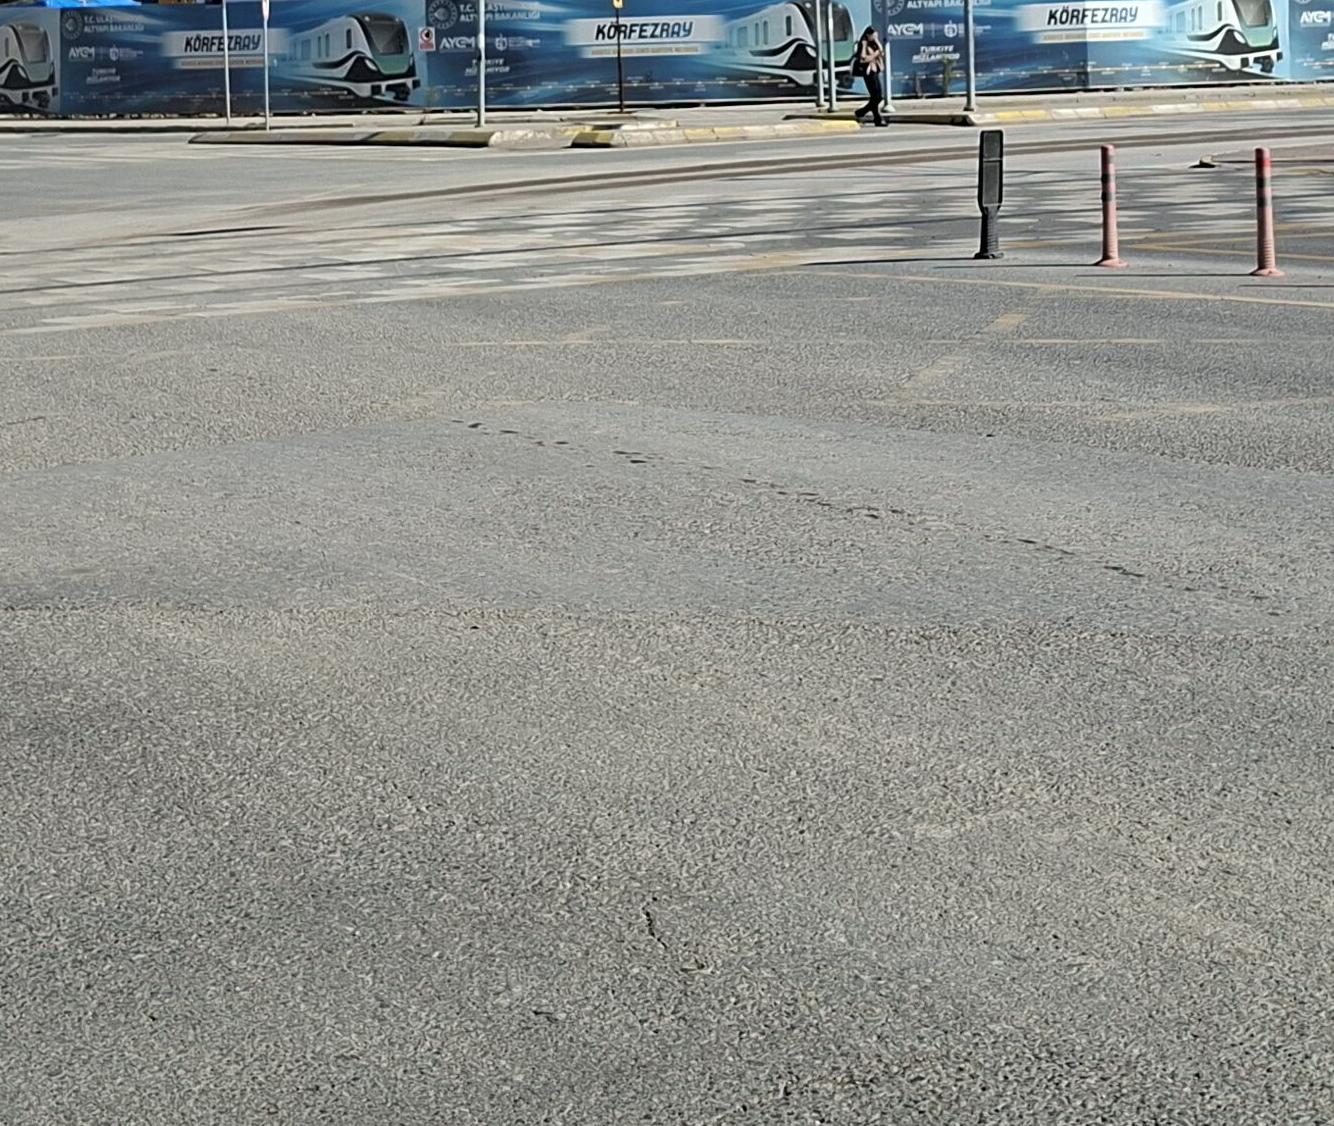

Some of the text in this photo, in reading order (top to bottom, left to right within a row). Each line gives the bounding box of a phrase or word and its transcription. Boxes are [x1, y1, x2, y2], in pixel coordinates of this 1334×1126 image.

[907, 0, 943, 8] ALTYAPI
[1046, 5, 1139, 26] KÖRFEZRAY
[595, 21, 694, 41] KÖRFEZRAY
[184, 34, 261, 53] KÖRFEZRAY
